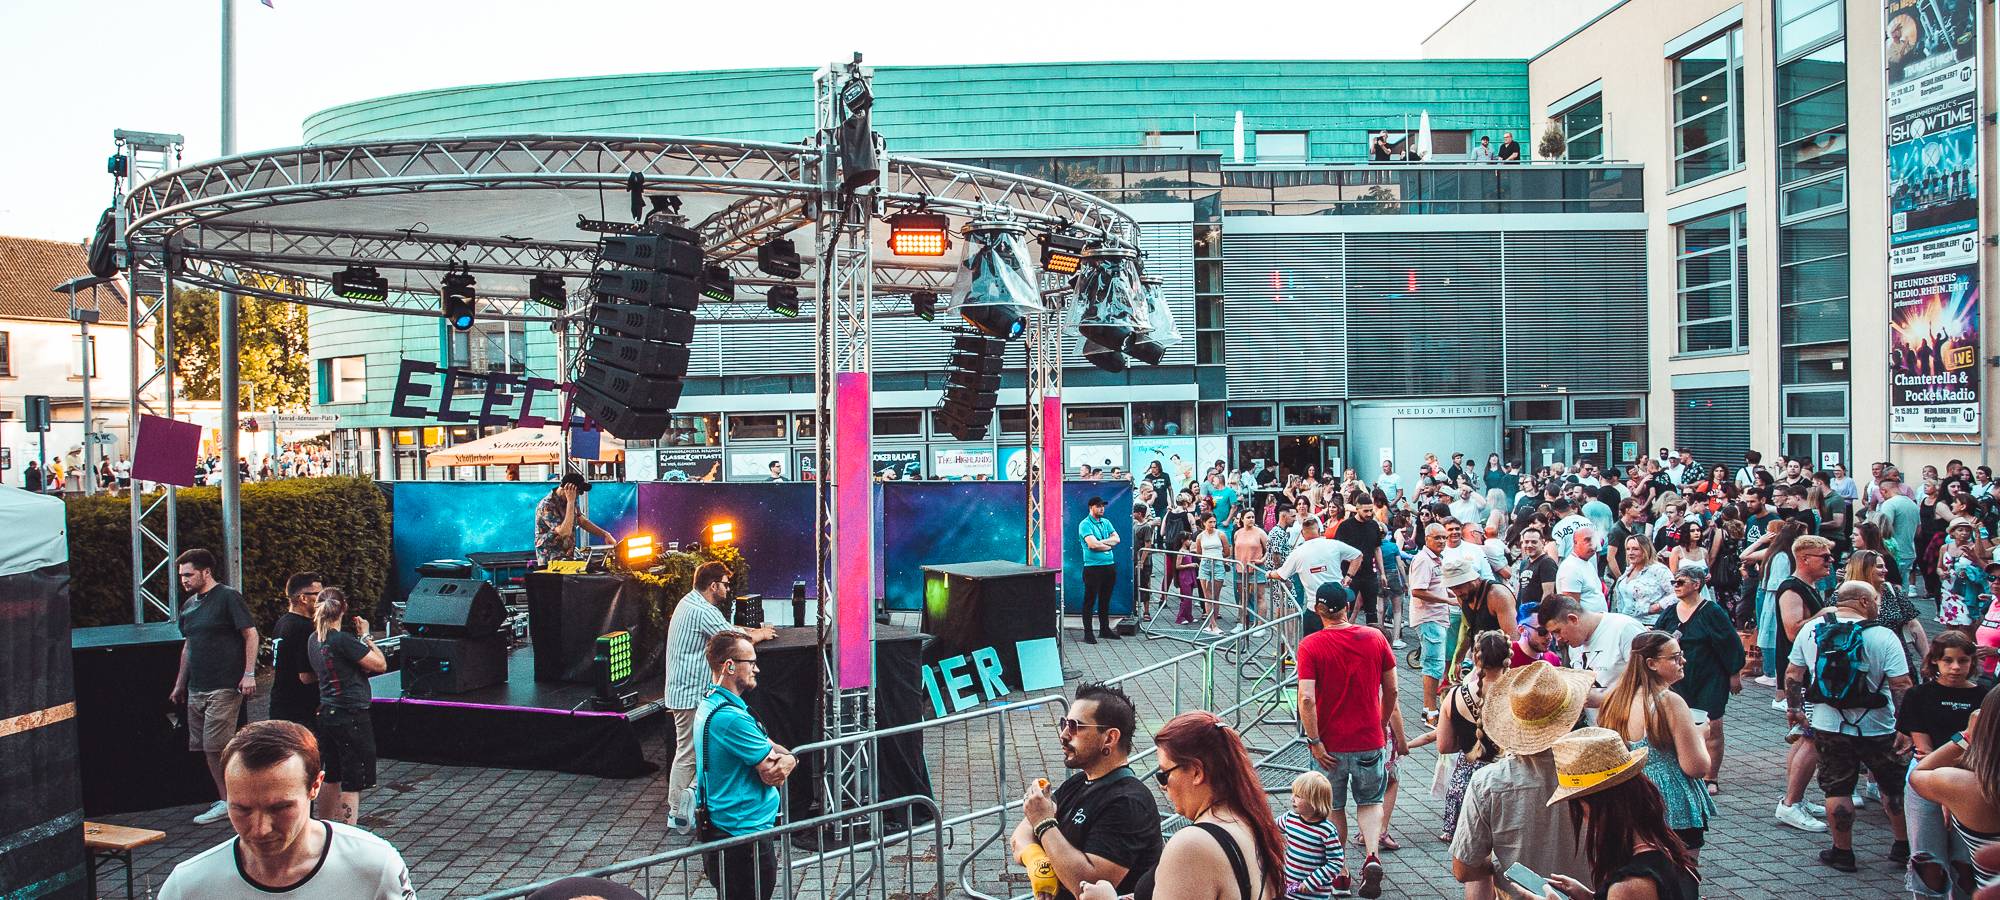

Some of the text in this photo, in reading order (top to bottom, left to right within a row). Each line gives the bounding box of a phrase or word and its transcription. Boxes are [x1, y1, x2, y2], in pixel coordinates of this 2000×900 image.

[1892, 104, 1972, 141] SHOWTIME
[1893, 273, 1957, 289] FREUNDESKREIS
[1893, 282, 1969, 299] MEDIO.RHEIN.ERFT
[1894, 371, 1968, 386] Chanterella &
[1905, 388, 1975, 401] Pocket Radio
